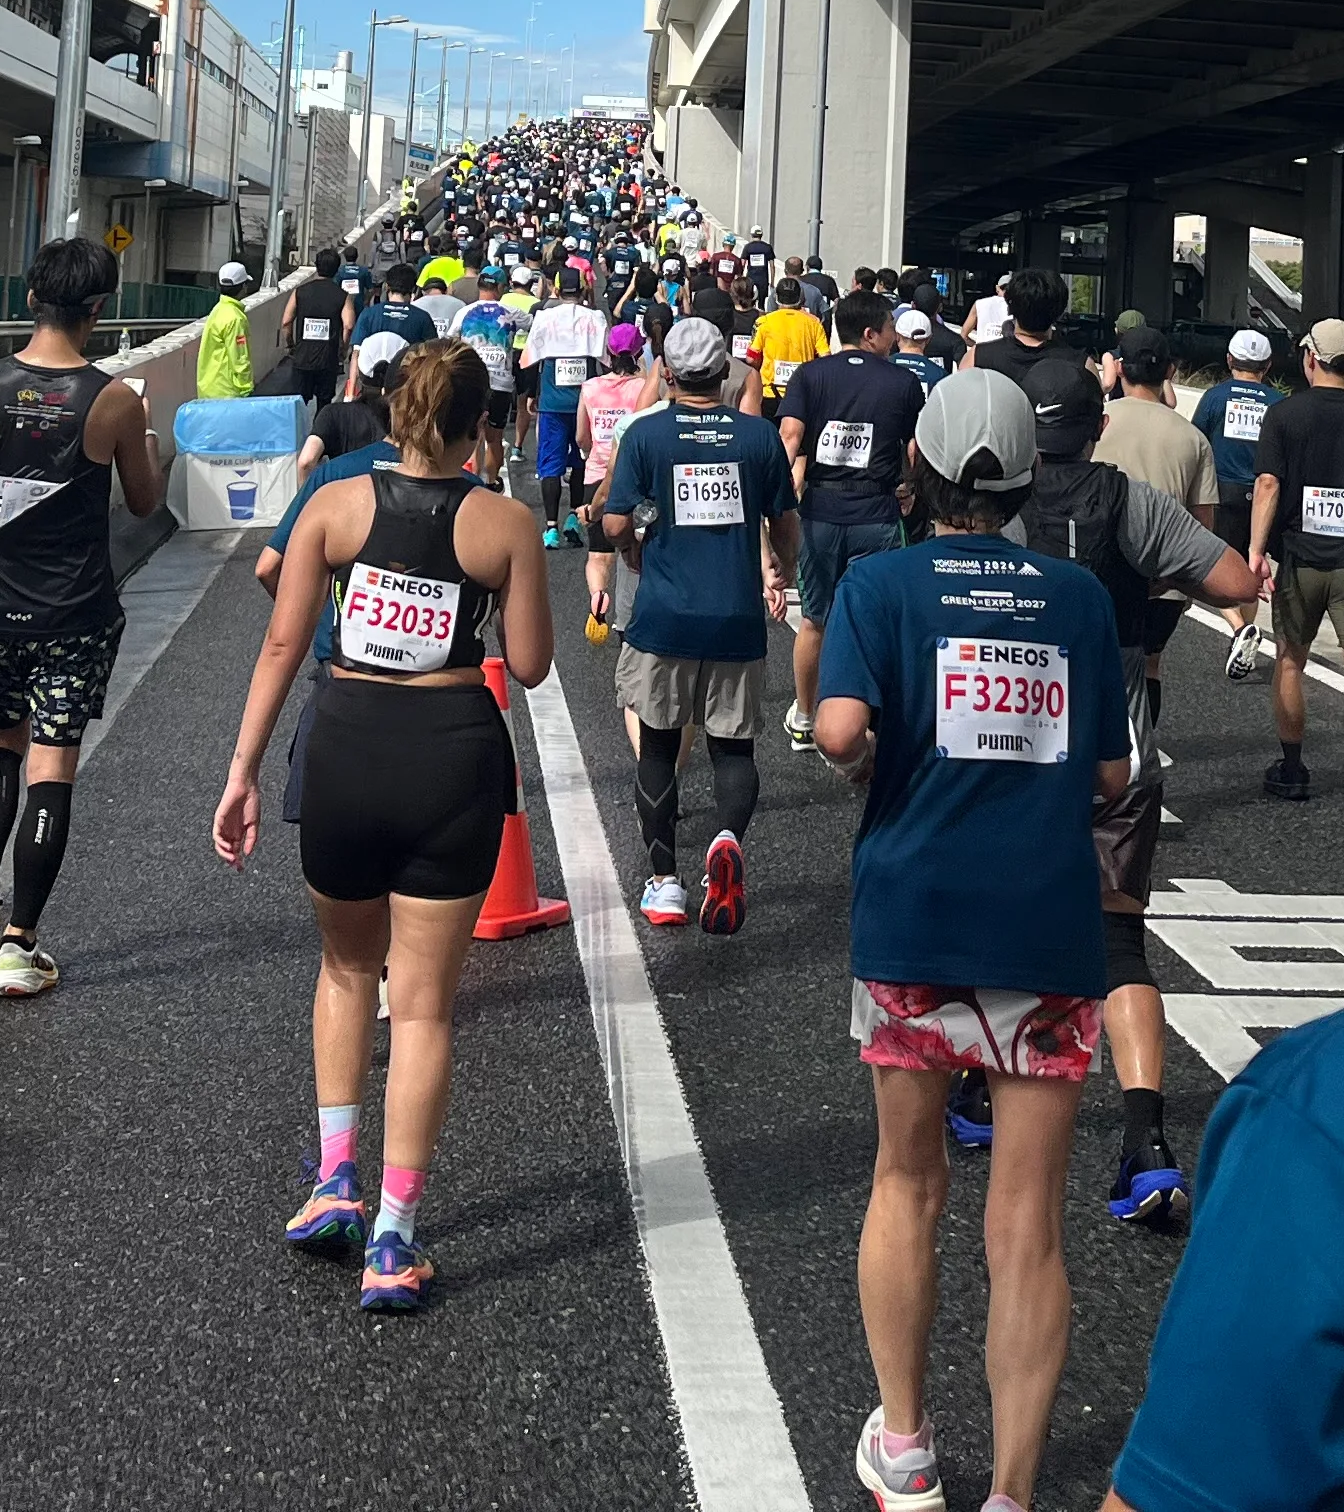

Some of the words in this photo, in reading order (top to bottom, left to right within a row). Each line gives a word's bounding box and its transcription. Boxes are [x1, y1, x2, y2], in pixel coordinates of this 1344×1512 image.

[1240, 404, 1265, 413] ENEOS
[836, 424, 865, 432] ENEOS
[821, 432, 871, 451] G14907
[209, 458, 234, 466] PAPER
[694, 465, 730, 477] ENEOS
[677, 480, 740, 502] G16956
[686, 511, 734, 520] NISSAN
[932, 558, 981, 569] YOKOHAMA
[984, 560, 1016, 570] 2026
[380, 574, 443, 600] ENEOS
[1016, 598, 1046, 609] 2027
[347, 591, 452, 640] F32033
[364, 641, 404, 662] PUMA
[979, 644, 1049, 668] ENEOS
[944, 673, 1065, 719] F32390
[977, 733, 1024, 752] PUMA
